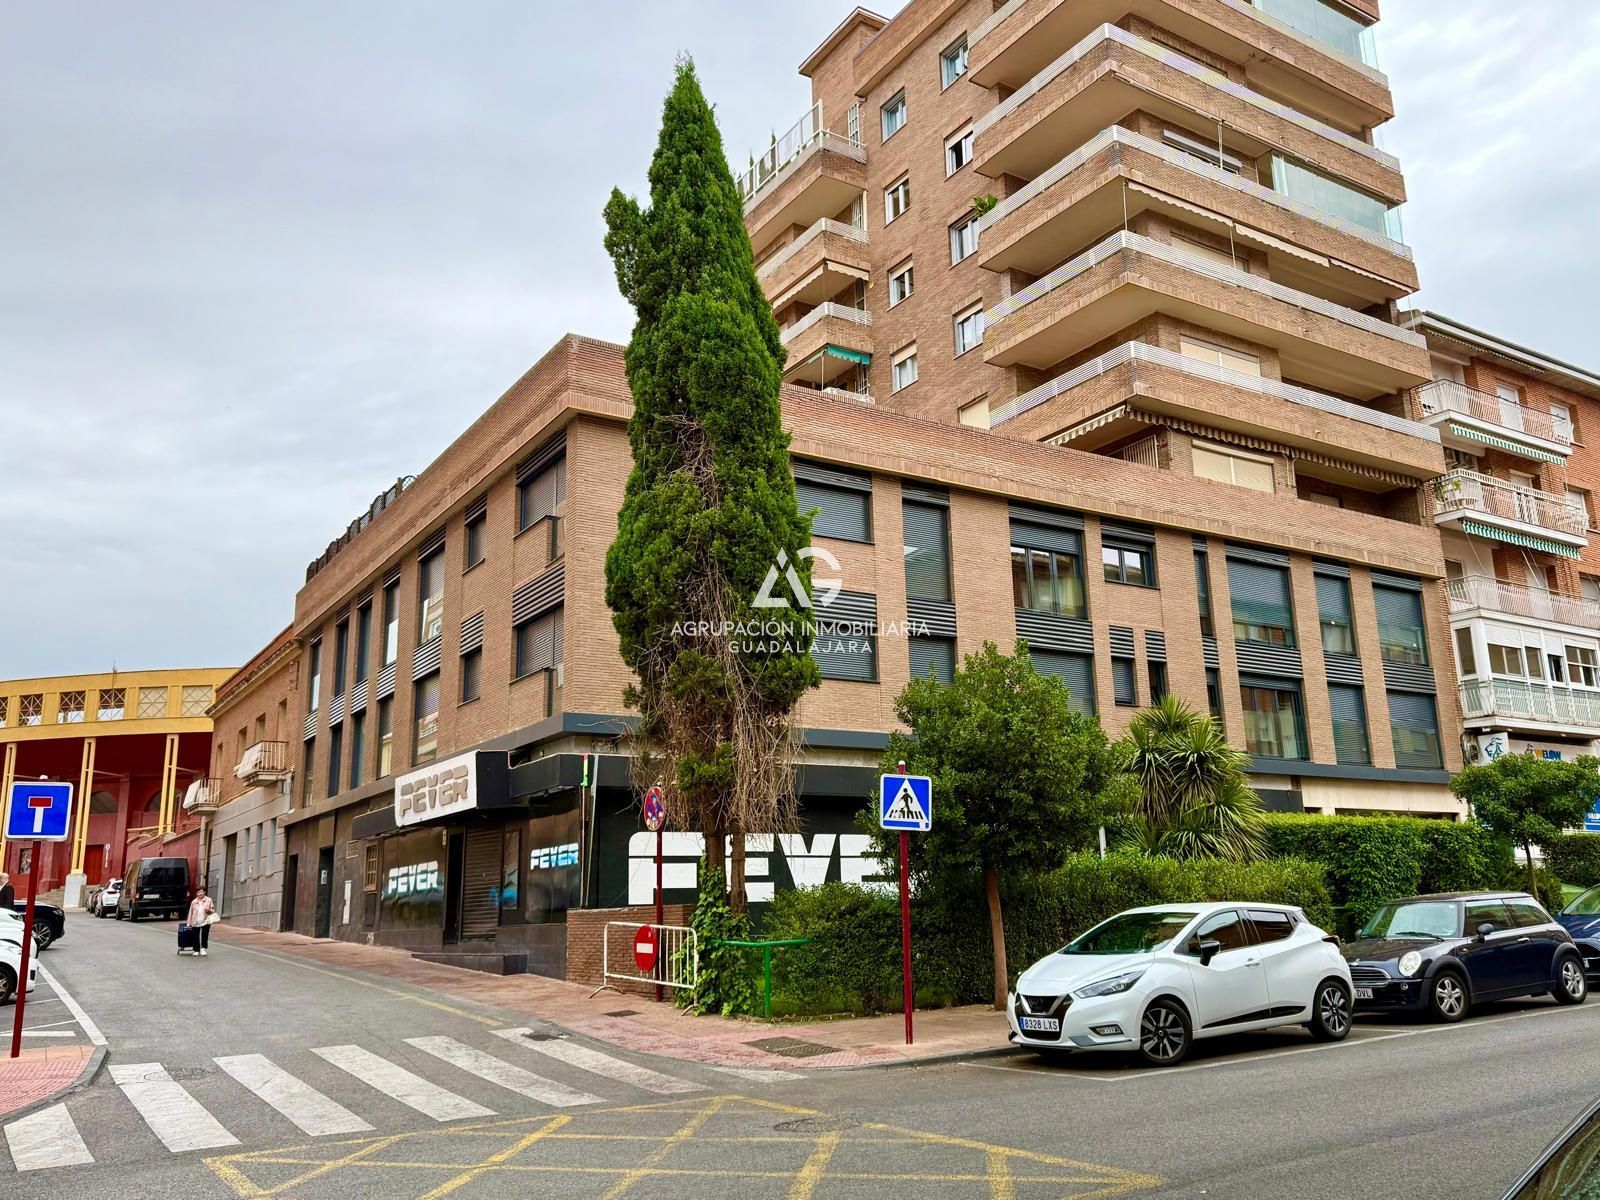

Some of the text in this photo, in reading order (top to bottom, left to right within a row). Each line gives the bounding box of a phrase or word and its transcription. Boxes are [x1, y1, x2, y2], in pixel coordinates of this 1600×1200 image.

[399, 764, 469, 817] FEVER
[530, 842, 579, 870] FEVER
[387, 860, 439, 895] FEVER
[1024, 1019, 1058, 1031] 8328 LXS
